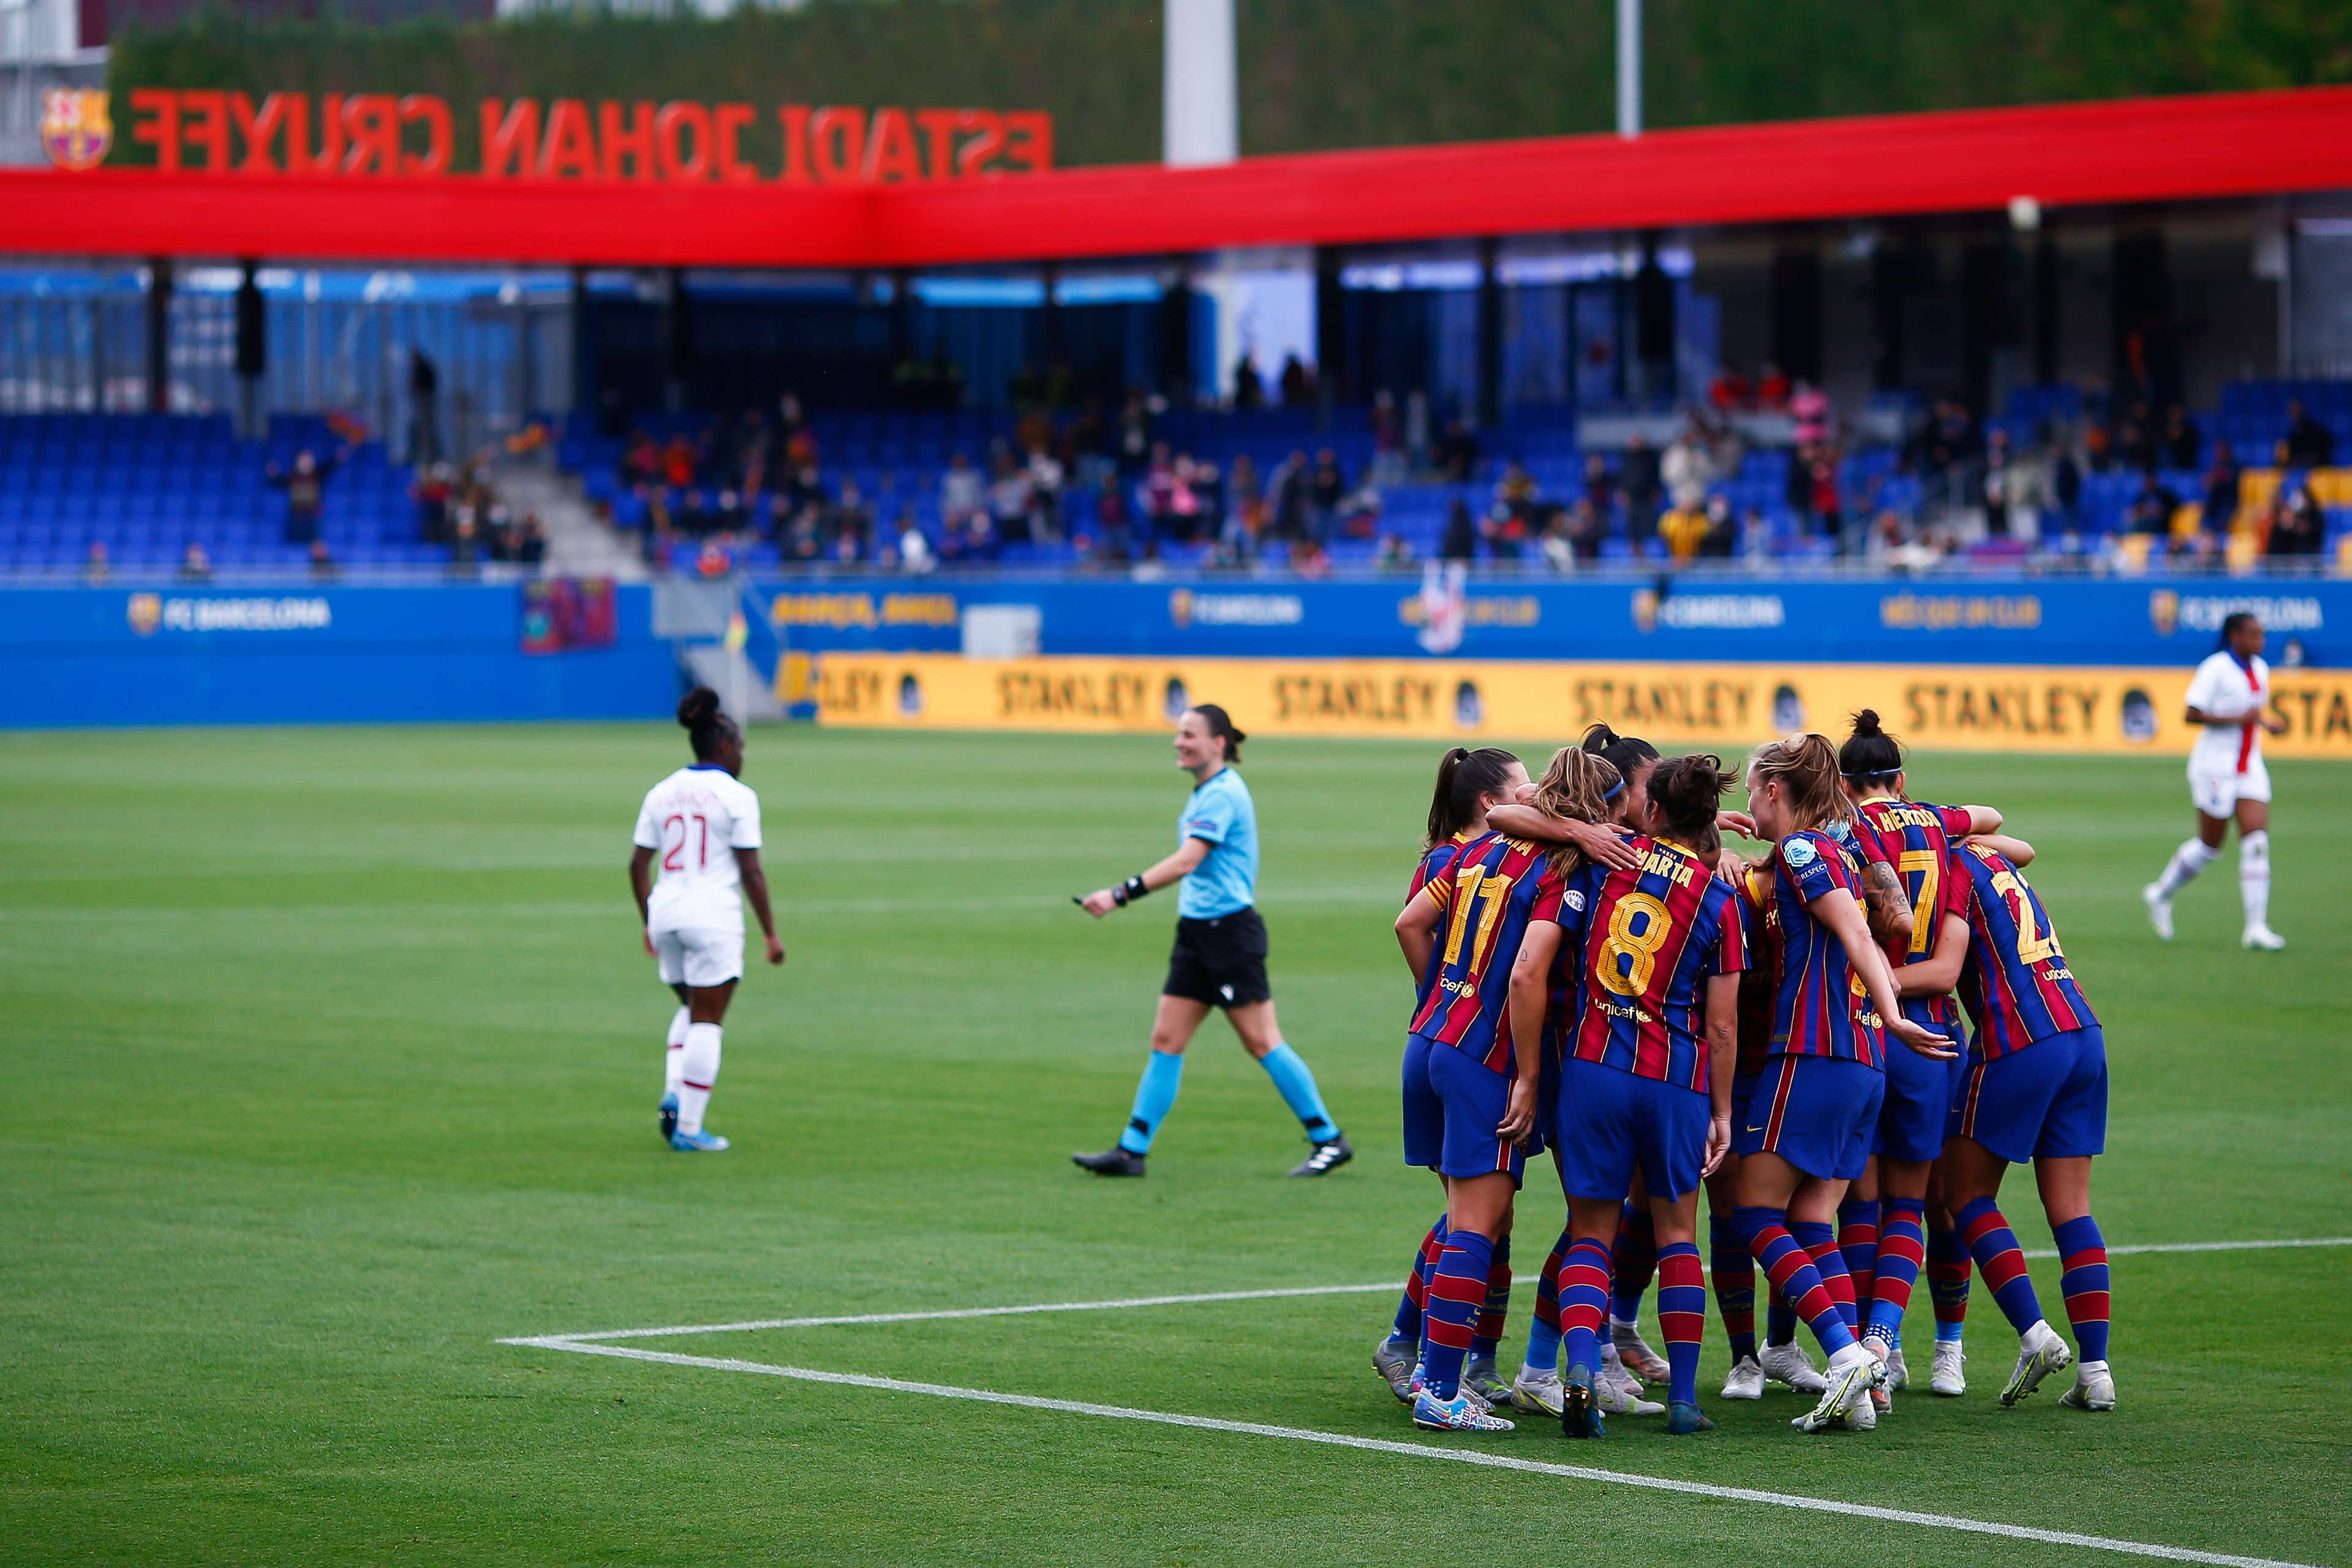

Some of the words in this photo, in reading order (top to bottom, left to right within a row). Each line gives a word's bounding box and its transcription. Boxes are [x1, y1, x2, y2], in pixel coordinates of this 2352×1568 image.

[1000, 670, 1151, 715] STANLEY
[1274, 674, 1437, 721] STANLEY
[1575, 679, 1753, 728] STANLEY
[1905, 683, 2101, 734] STANLEY
[1800, 863, 1828, 880] RESPECT
[1443, 864, 1513, 976] 11
[1899, 850, 1939, 953] 7
[1596, 892, 1673, 997] 8
[1595, 998, 1635, 1019] unicef
